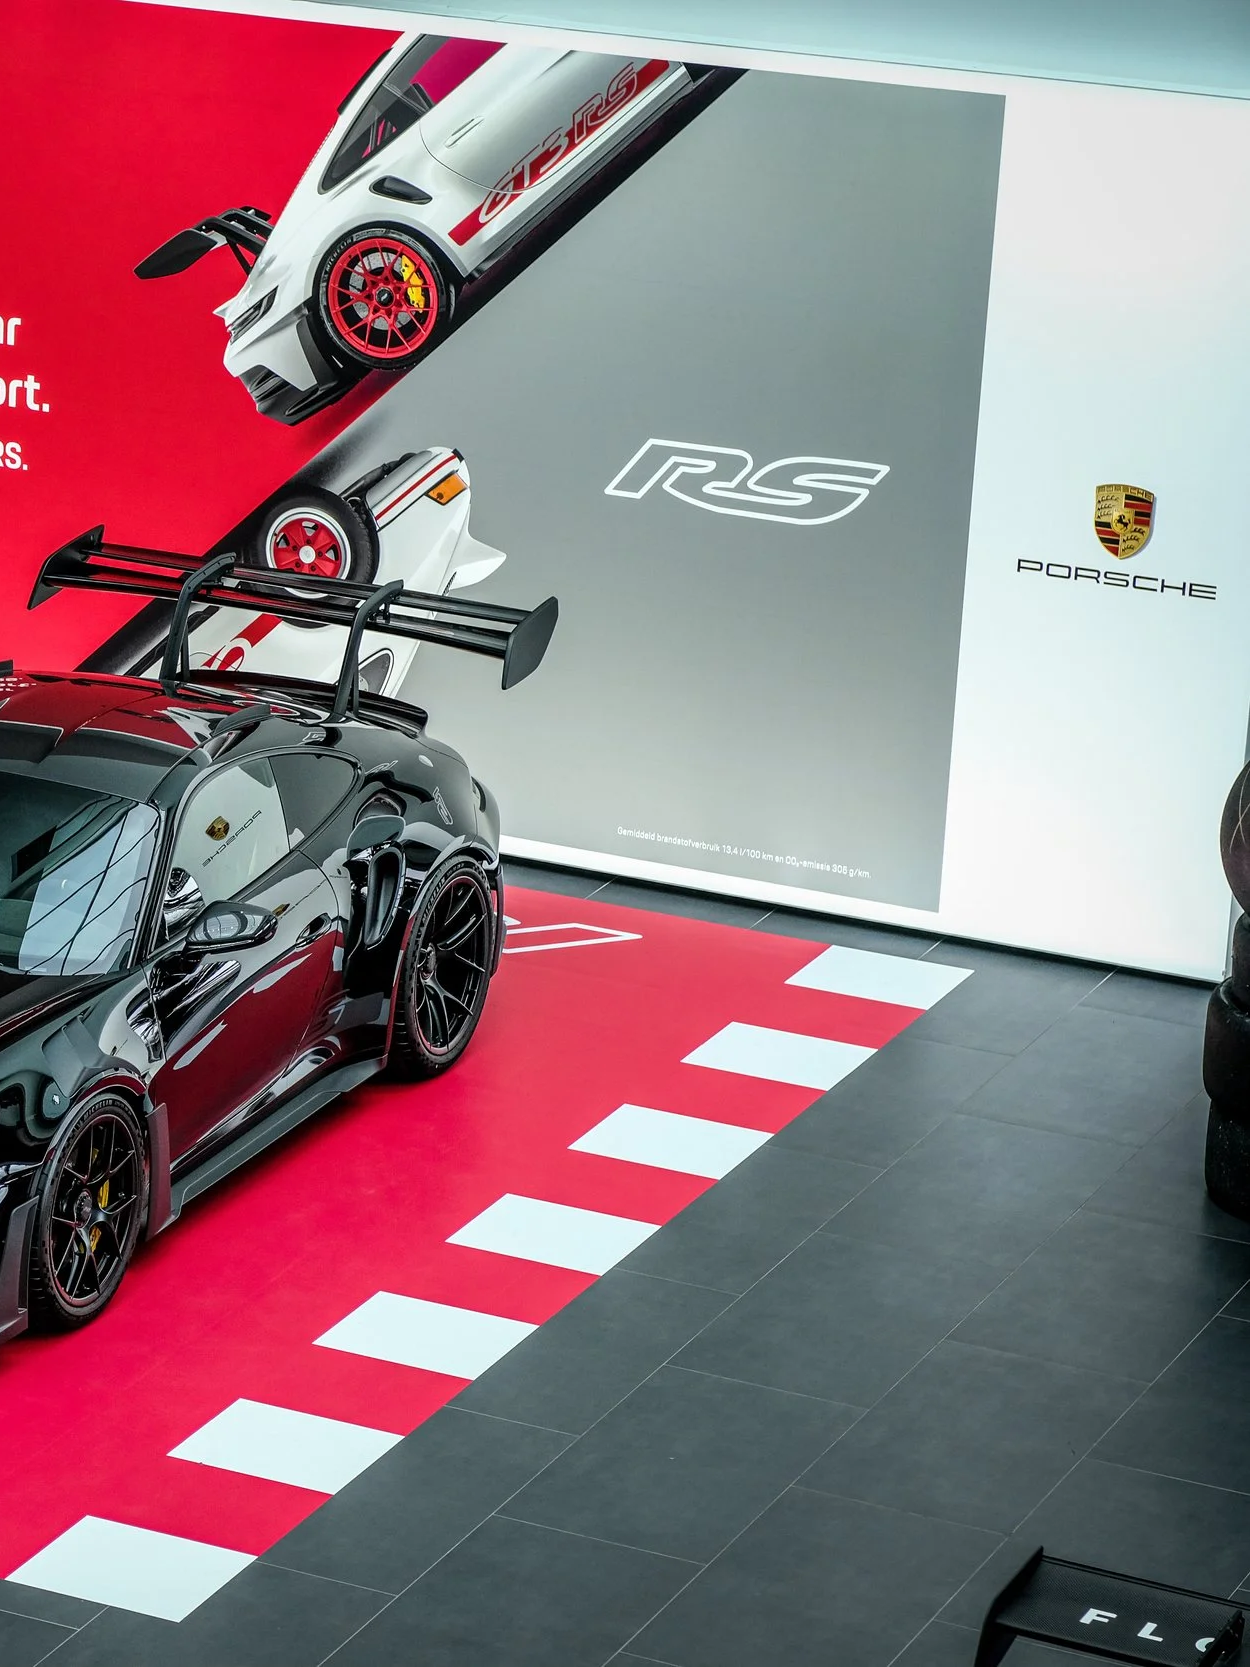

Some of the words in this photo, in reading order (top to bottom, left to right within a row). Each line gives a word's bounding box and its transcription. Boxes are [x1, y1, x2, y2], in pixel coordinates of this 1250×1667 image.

[478, 126, 569, 224] GT3
[573, 62, 637, 144] RS
[604, 438, 890, 525] RS
[1017, 558, 1217, 600] PORSCHE
[617, 826, 655, 840] Gemiddeld
[657, 833, 720, 852] brandstofverbruik
[723, 845, 738, 855] 13,4
[740, 848, 761, 859] l/100
[762, 852, 774, 861] km
[849, 867, 872, 878] g/km.
